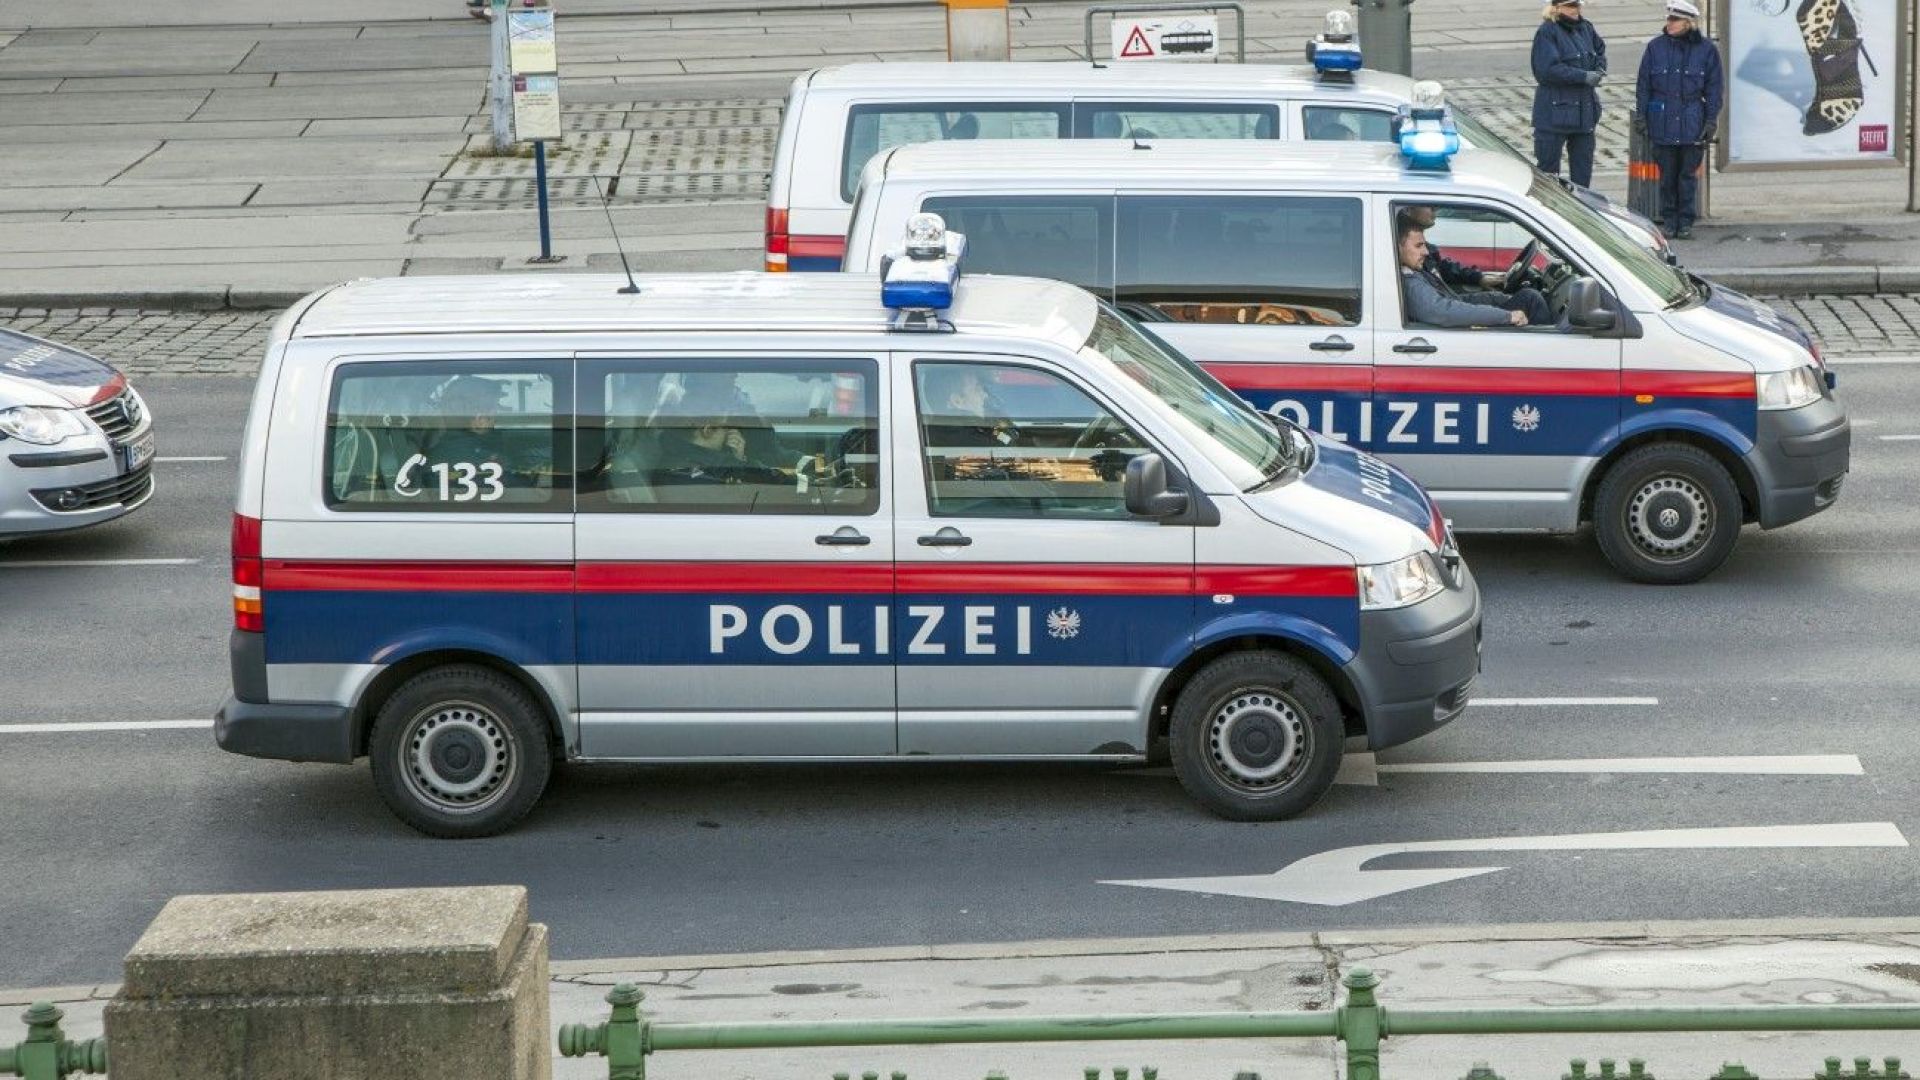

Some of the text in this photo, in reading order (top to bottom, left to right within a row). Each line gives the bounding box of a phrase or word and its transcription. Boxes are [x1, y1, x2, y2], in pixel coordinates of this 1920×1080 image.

[1244, 399, 1488, 444] OLIZEI
[431, 462, 504, 502] 133
[709, 604, 1031, 655] POLIZEI
